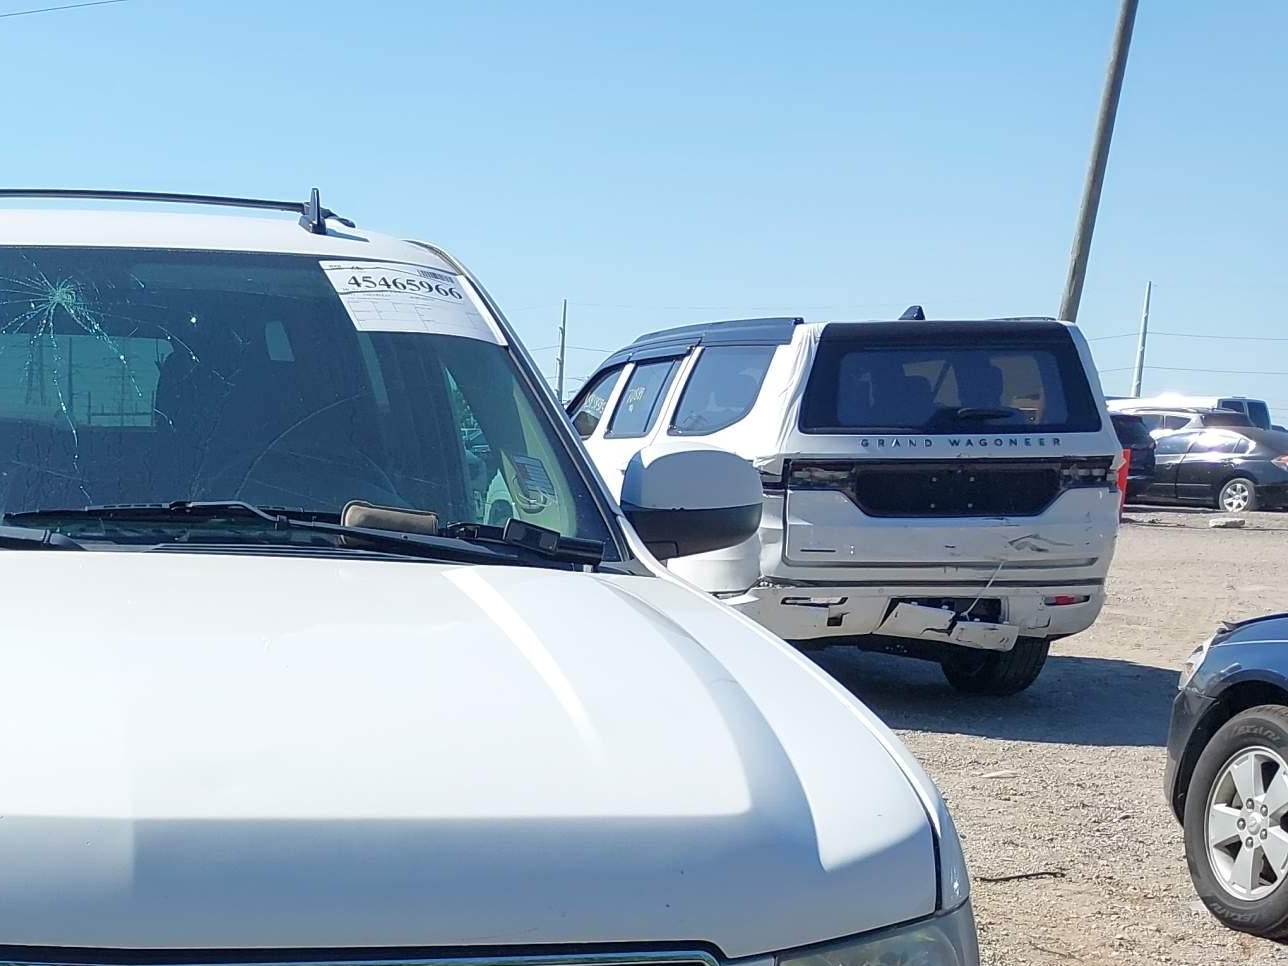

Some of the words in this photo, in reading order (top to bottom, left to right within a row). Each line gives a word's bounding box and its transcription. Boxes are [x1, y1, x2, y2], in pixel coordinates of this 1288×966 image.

[347, 275, 463, 300] 45465966
[860, 438, 933, 448] GRAND
[948, 437, 1062, 448] WAGONEER
